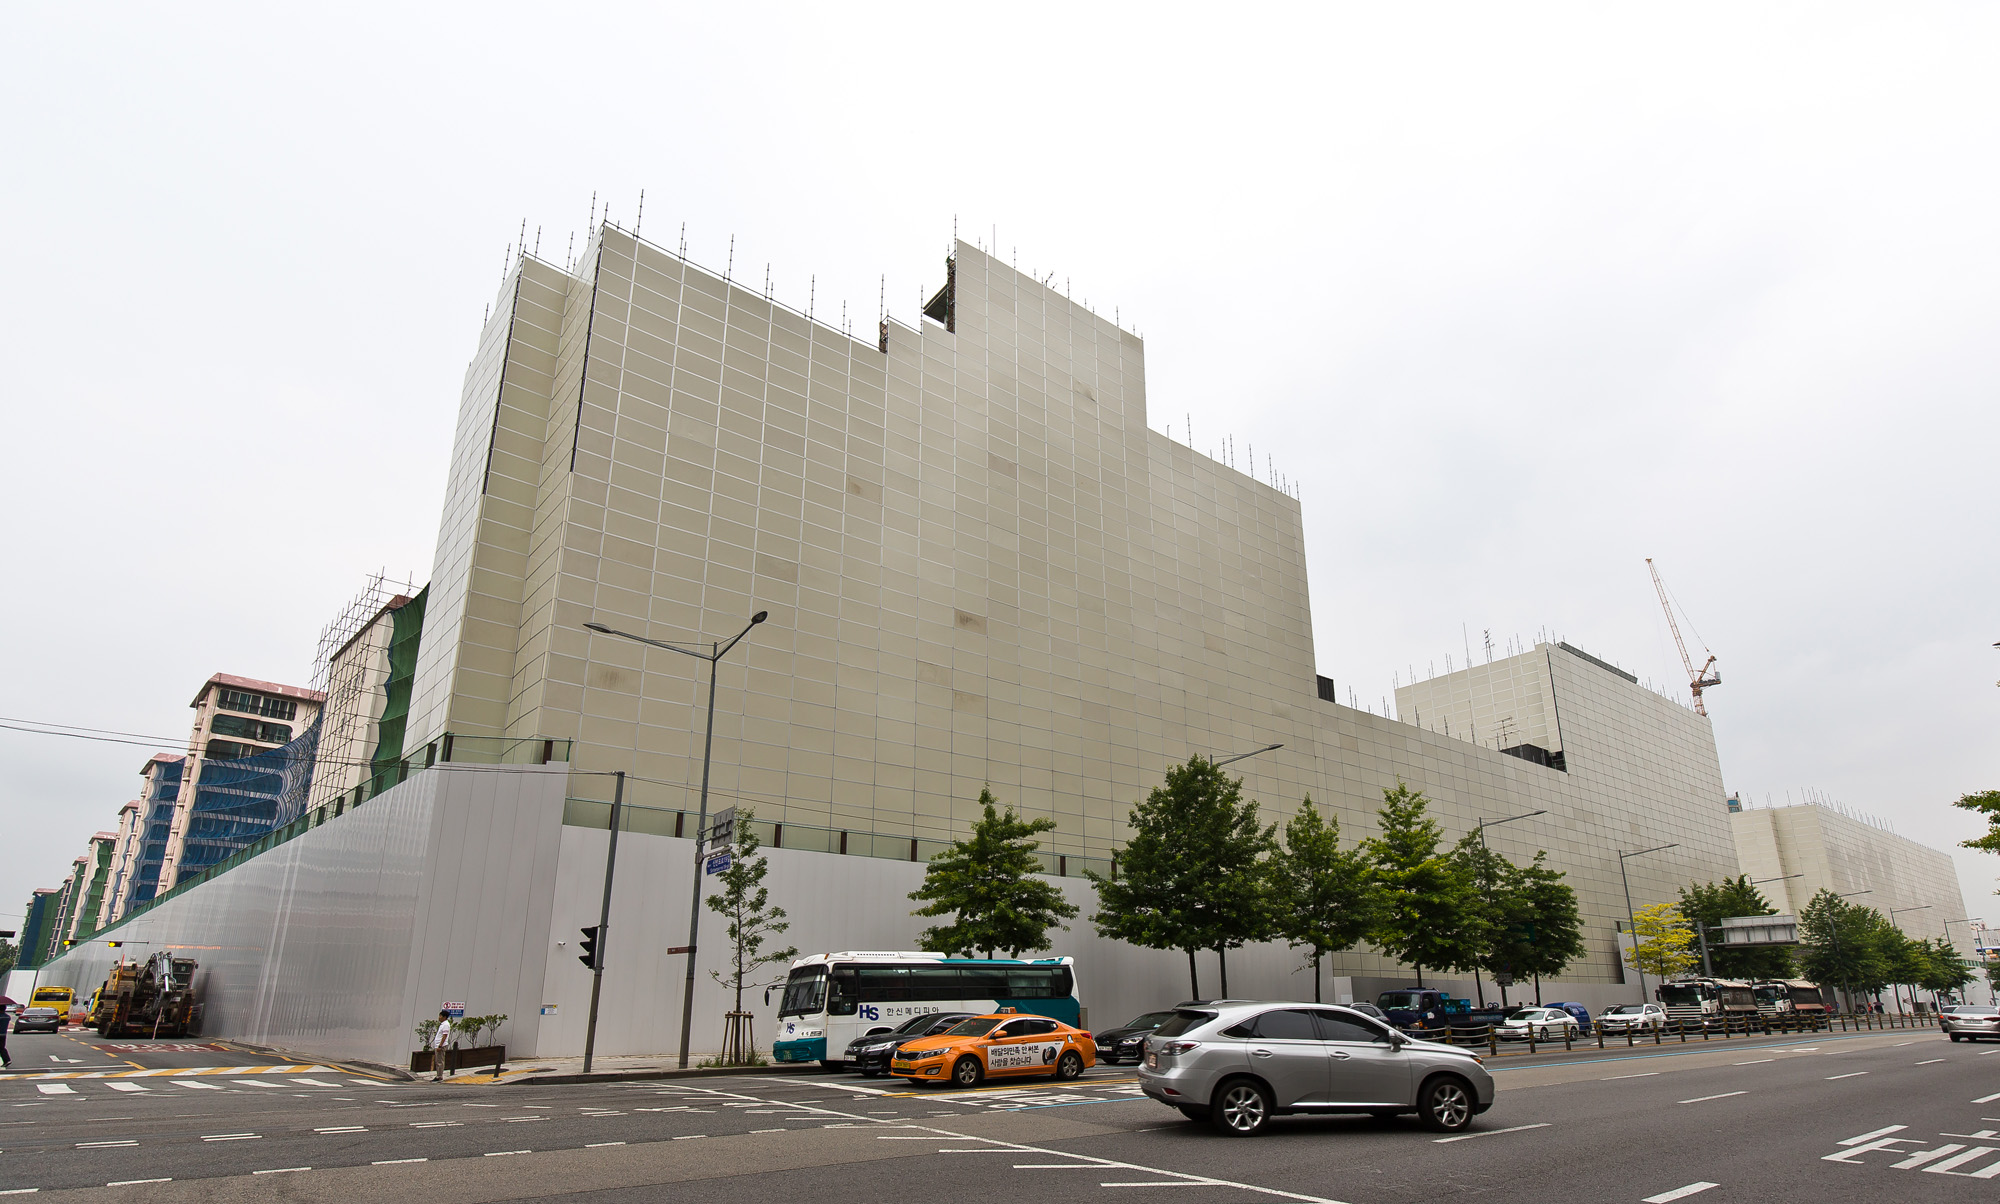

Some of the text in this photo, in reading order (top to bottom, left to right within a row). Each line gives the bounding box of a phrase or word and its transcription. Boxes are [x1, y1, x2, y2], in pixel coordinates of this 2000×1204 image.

[859, 1004, 879, 1021] HS
[786, 1022, 796, 1034] HS
[990, 1046, 1020, 1057] 배달의민족
[990, 1055, 1032, 1067] 사람을 찾습니다
